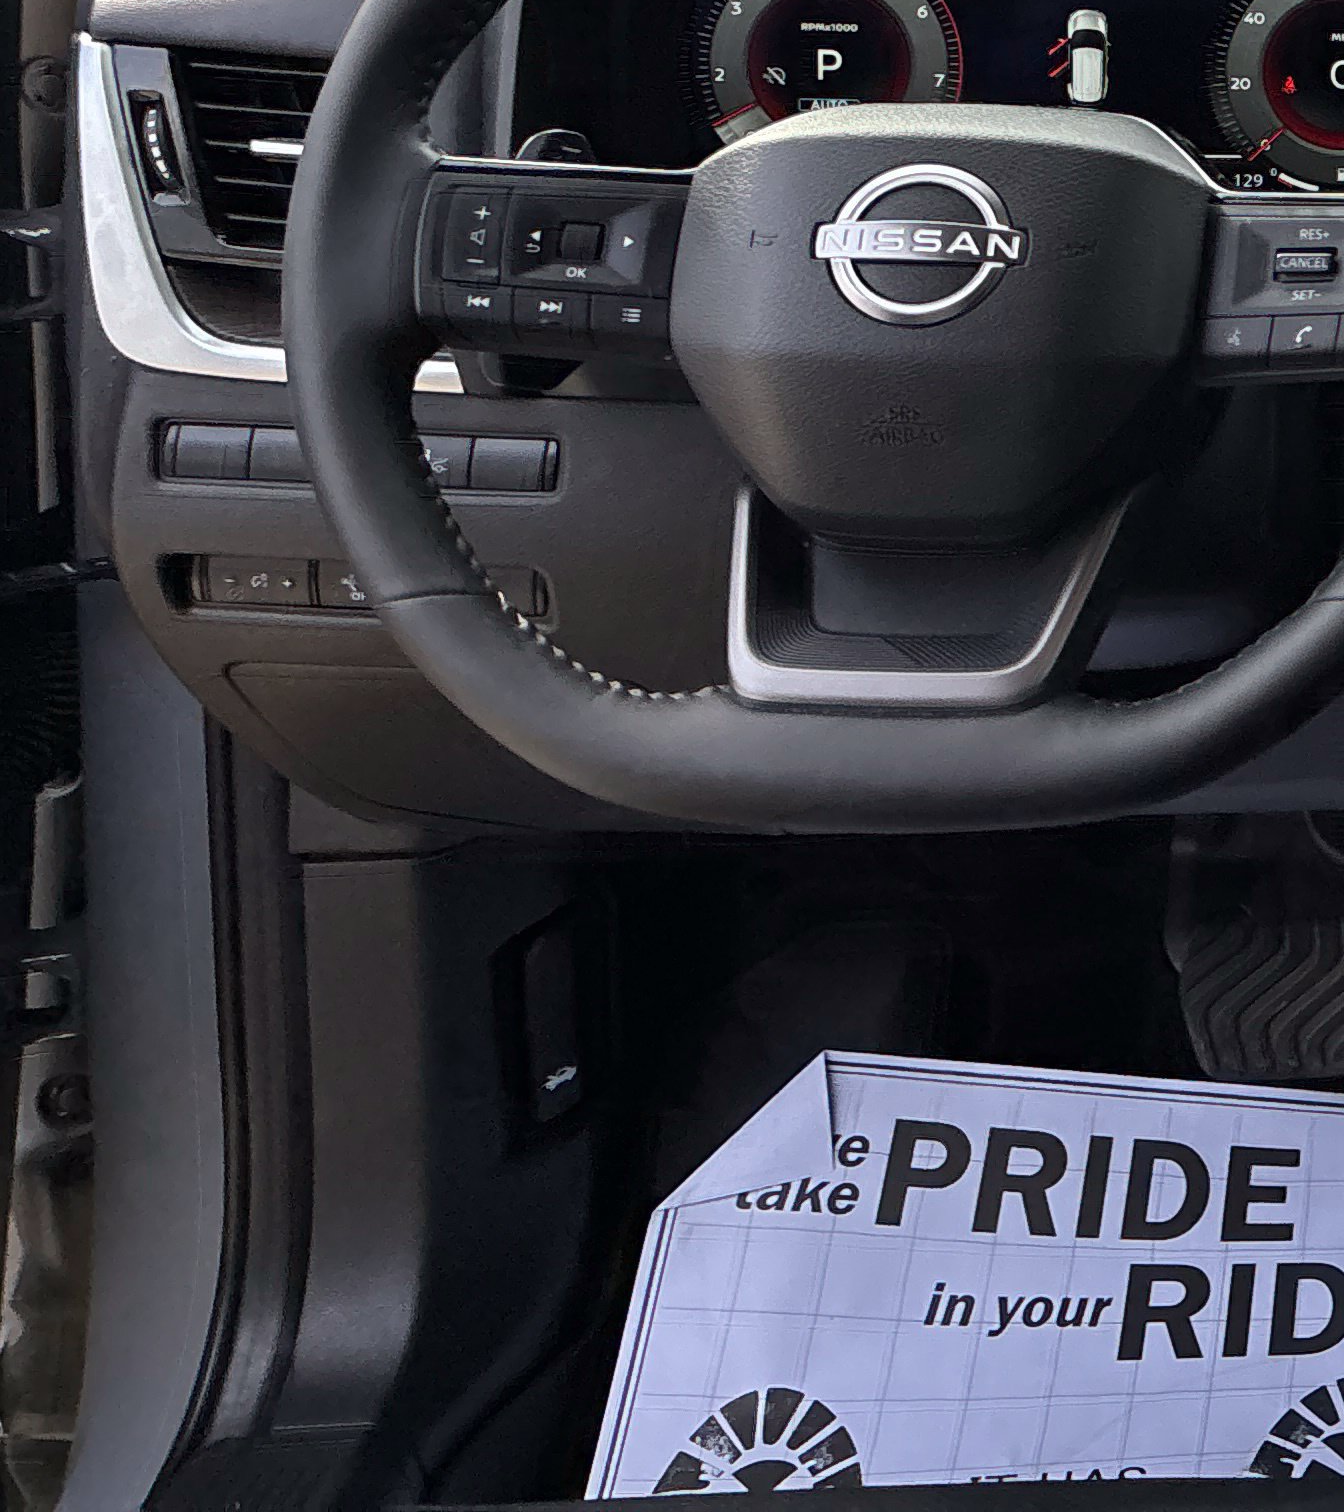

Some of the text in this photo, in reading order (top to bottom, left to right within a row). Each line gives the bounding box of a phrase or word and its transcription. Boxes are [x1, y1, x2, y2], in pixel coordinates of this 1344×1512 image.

[731, 1, 742, 16] 3
[917, 5, 928, 18] 6
[1244, 11, 1265, 26] 40
[817, 49, 843, 80] P
[714, 68, 725, 82] 2
[934, 74, 944, 87] 7
[1230, 77, 1251, 91] 20
[1234, 174, 1263, 188] 129
[821, 227, 1021, 260] NISSAN
[1279, 256, 1329, 270] CANCEL
[566, 267, 587, 279] OK
[875, 1118, 1302, 1244] PRIDE
[923, 1283, 974, 1329] in
[988, 1289, 1112, 1339] your
